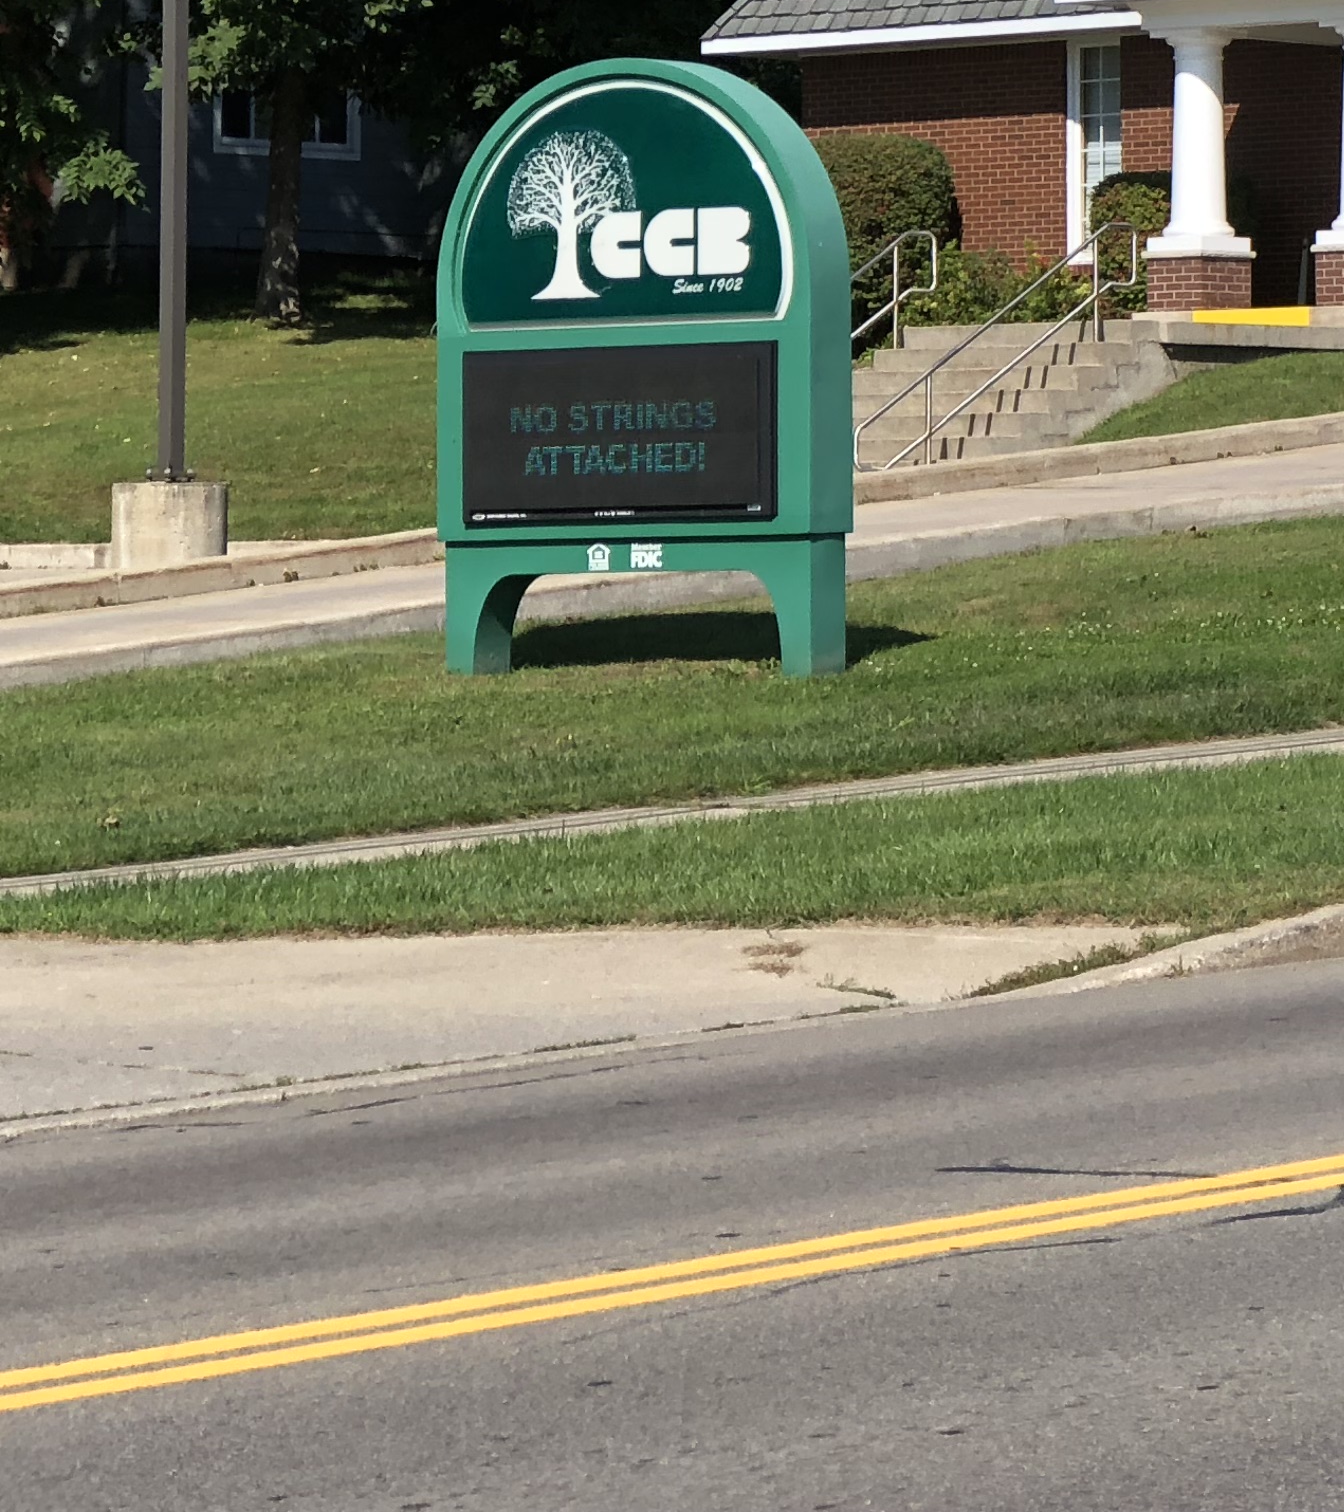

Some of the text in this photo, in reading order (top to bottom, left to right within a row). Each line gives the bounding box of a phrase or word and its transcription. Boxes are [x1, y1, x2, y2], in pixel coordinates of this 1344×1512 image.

[590, 206, 751, 279] CCB
[672, 277, 744, 294] Since 1902
[510, 399, 717, 434] NO STRINGS
[525, 441, 705, 476] ATTACHED!
[631, 551, 663, 568] FDIC
